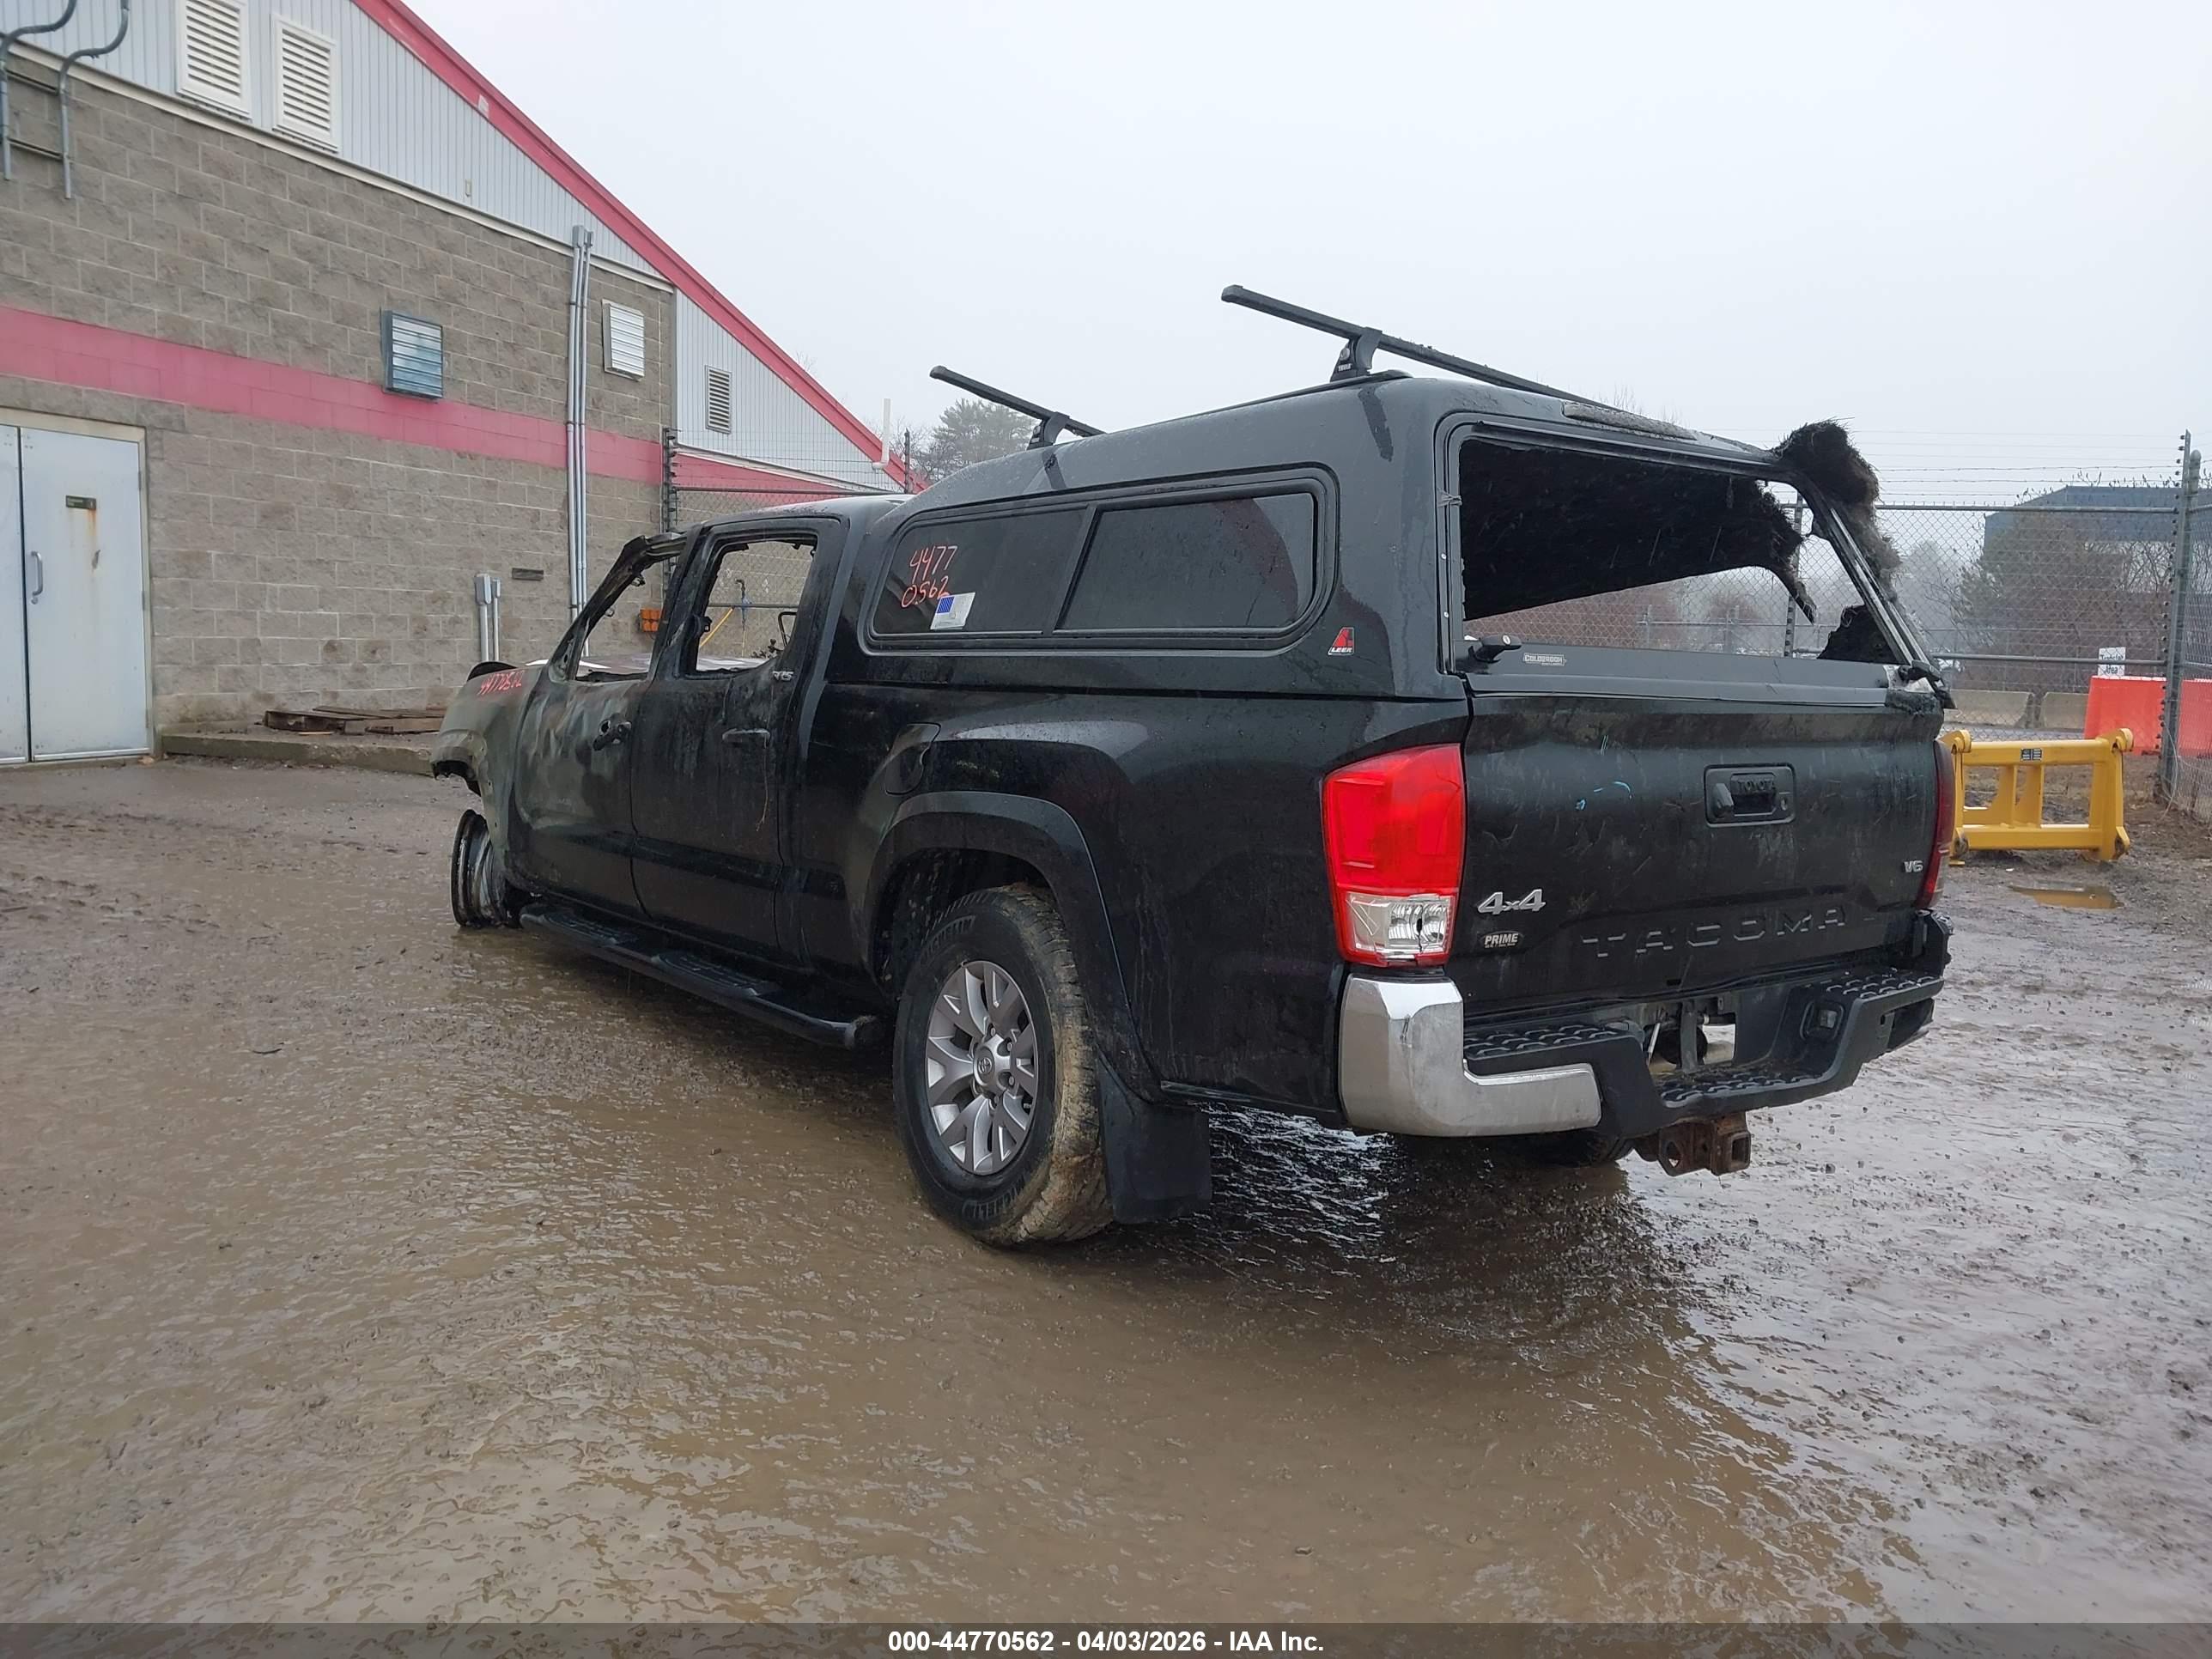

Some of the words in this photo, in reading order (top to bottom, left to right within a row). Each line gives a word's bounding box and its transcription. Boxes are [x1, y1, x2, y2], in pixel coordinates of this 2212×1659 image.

[909, 545, 958, 584] 4477
[901, 575, 951, 608] 0562
[1903, 860, 1923, 873] V6
[1477, 888, 1547, 915] 4x4
[1484, 933, 1519, 945] PRIME
[1580, 908, 1846, 958] TACOMA
